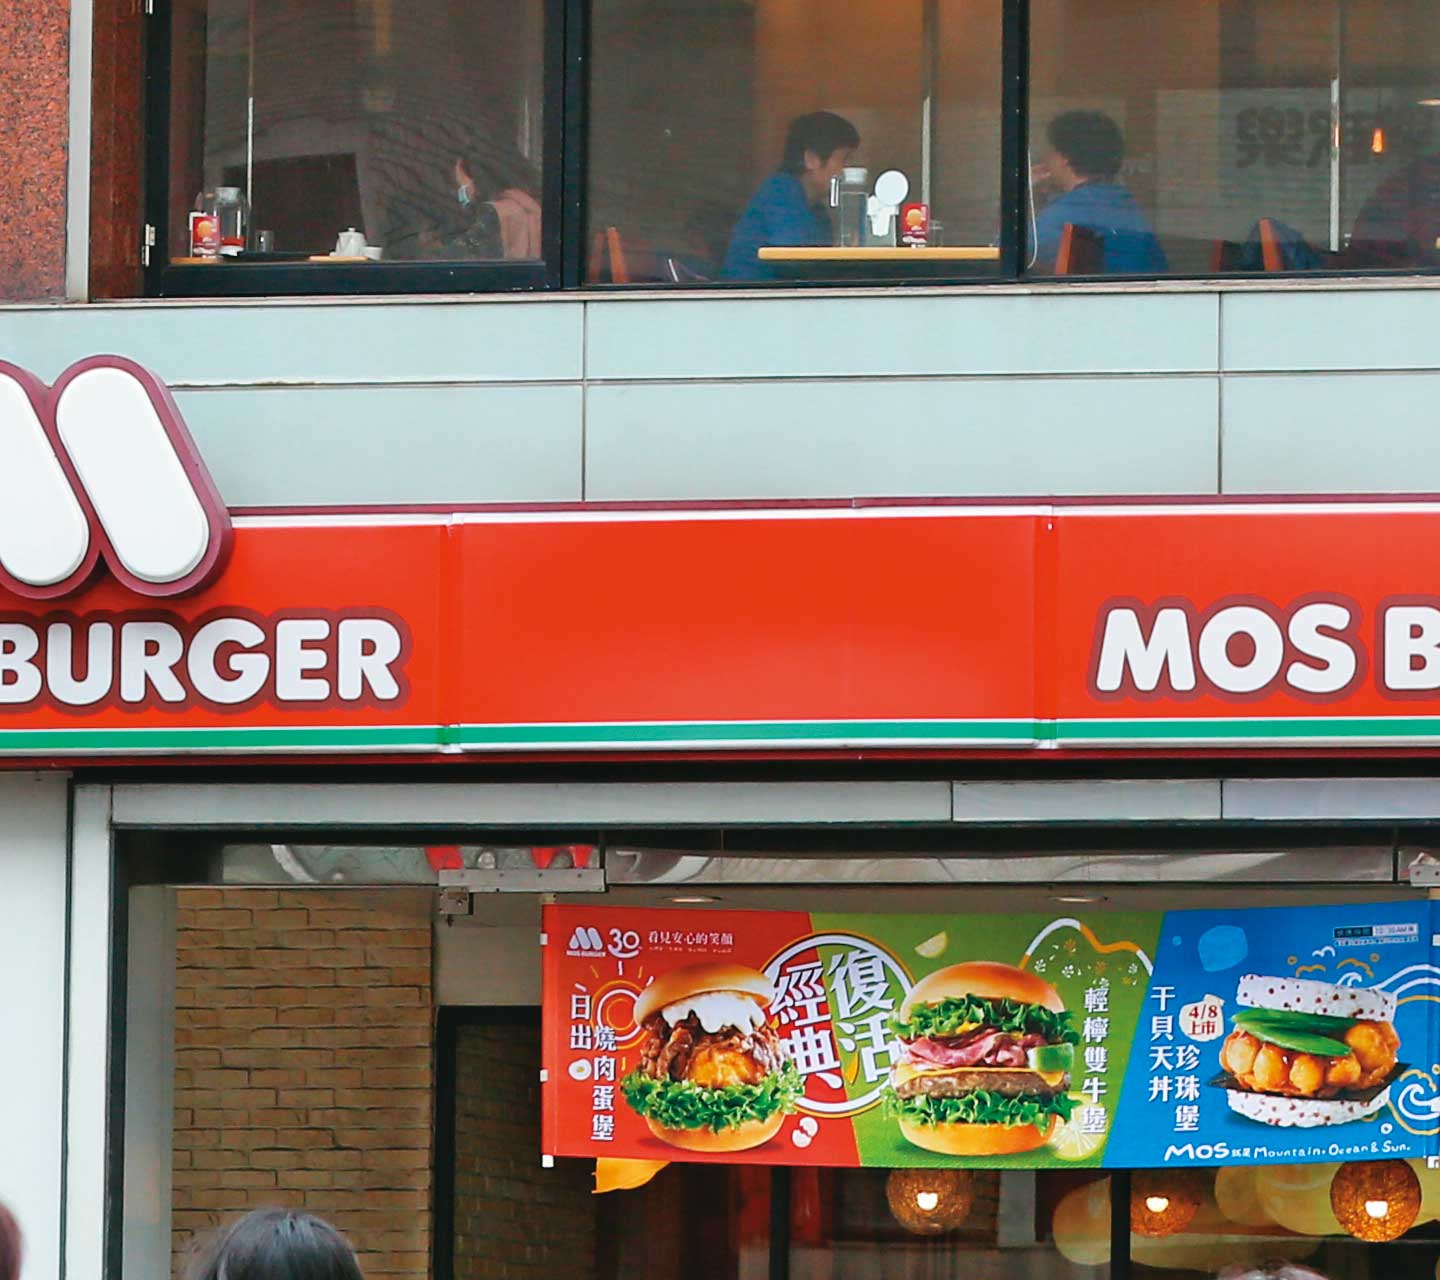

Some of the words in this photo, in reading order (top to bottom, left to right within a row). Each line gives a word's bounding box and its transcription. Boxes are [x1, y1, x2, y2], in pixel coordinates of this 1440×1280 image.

[1095, 602, 1358, 693] MOS
[570, 993, 592, 1050] 日出
[770, 960, 844, 1090] 經典
[826, 949, 896, 1083] 復活
[1148, 986, 1177, 1103] 干貝天丼
[1187, 1020, 1217, 1036] 上市
[1188, 1004, 1219, 1020] 4/8
[591, 1025, 617, 1141] 燒肉蛋堡
[1082, 987, 1109, 1134] 輕檸雙牛堡
[1173, 1045, 1201, 1133] 珍珠堡
[1164, 1142, 1231, 1161] MOS
[1329, 1144, 1368, 1155] Ocean
[1370, 1142, 1378, 1153] &
